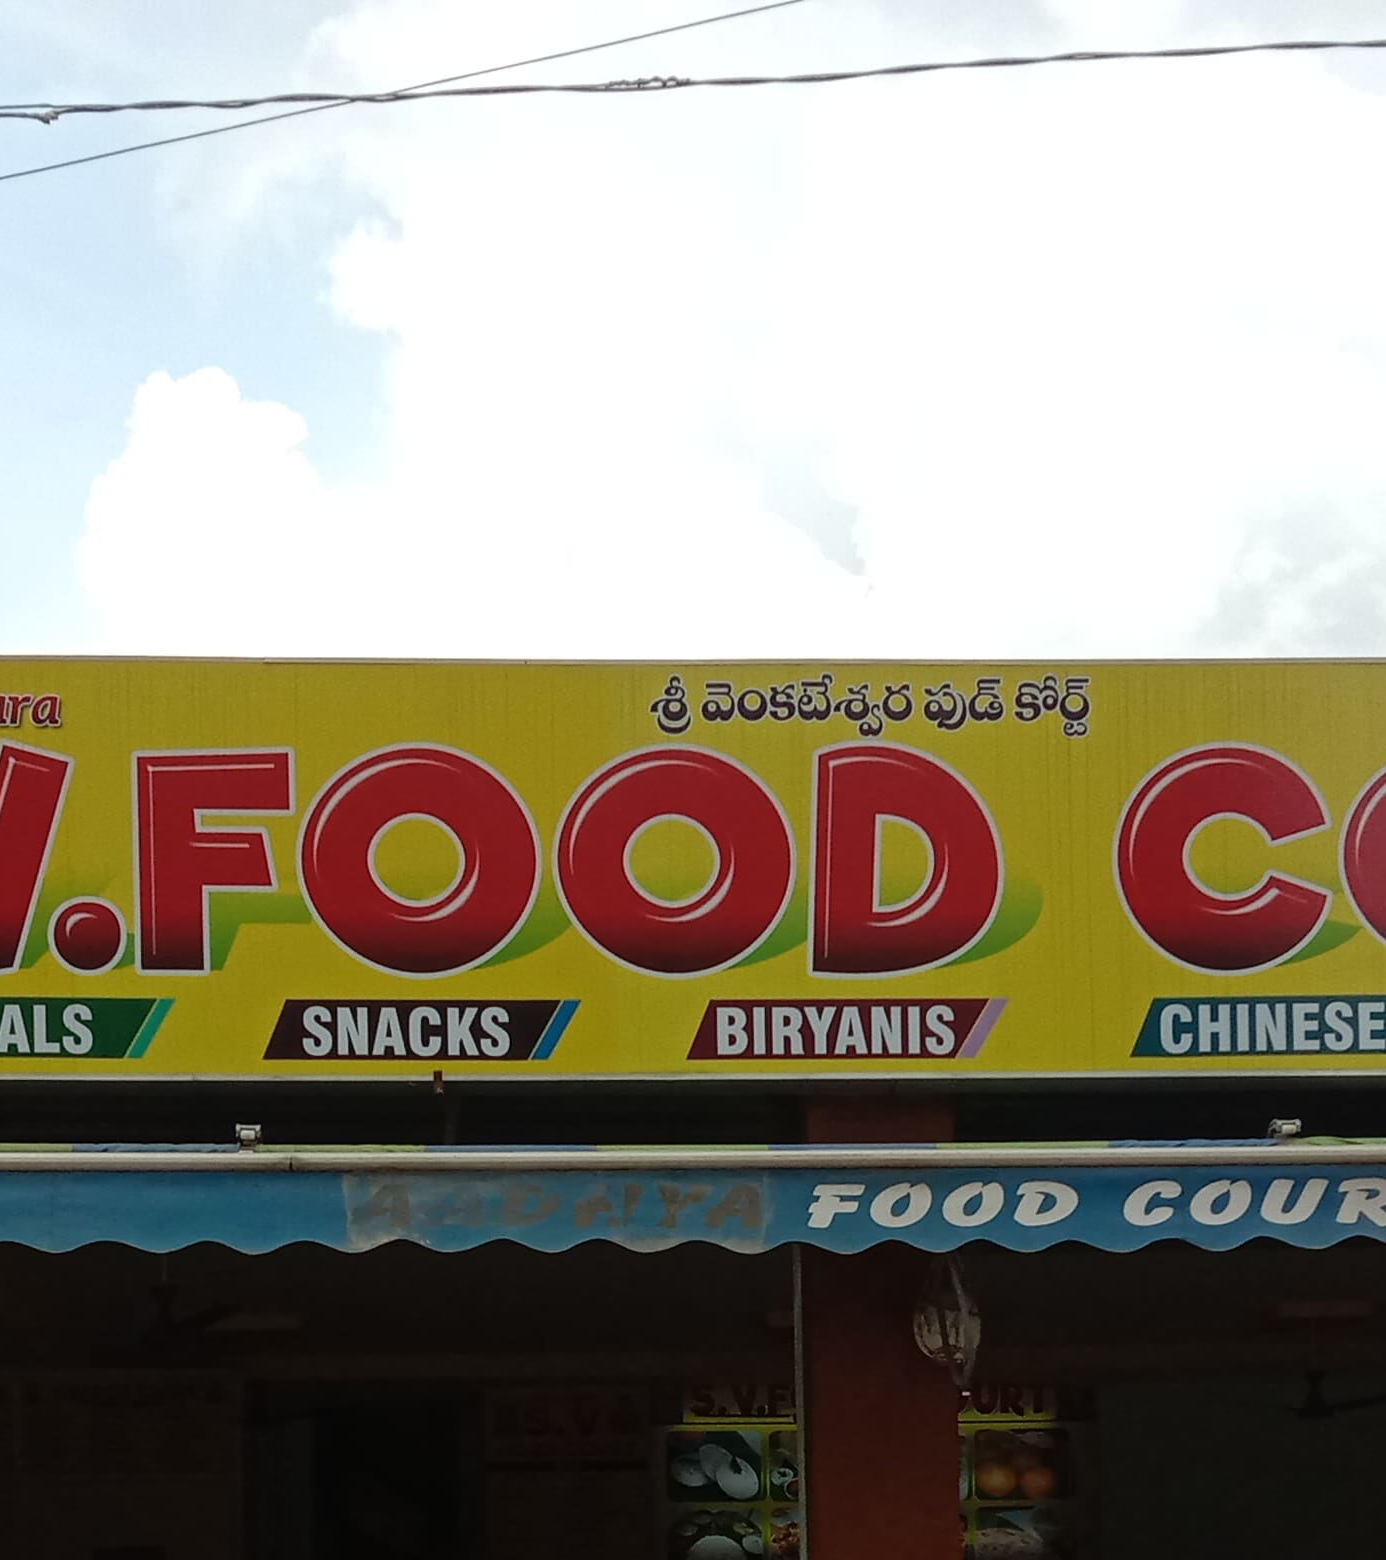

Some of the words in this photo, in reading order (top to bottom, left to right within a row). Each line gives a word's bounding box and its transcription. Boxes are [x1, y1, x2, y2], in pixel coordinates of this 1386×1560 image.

[649, 674, 692, 734] శ్రీ
[300, 1003, 511, 1057] SNACKS
[715, 1003, 957, 1056] BIRYANIS
[1157, 1001, 1386, 1054] CHINESE
[808, 1180, 1080, 1229] FOOD
